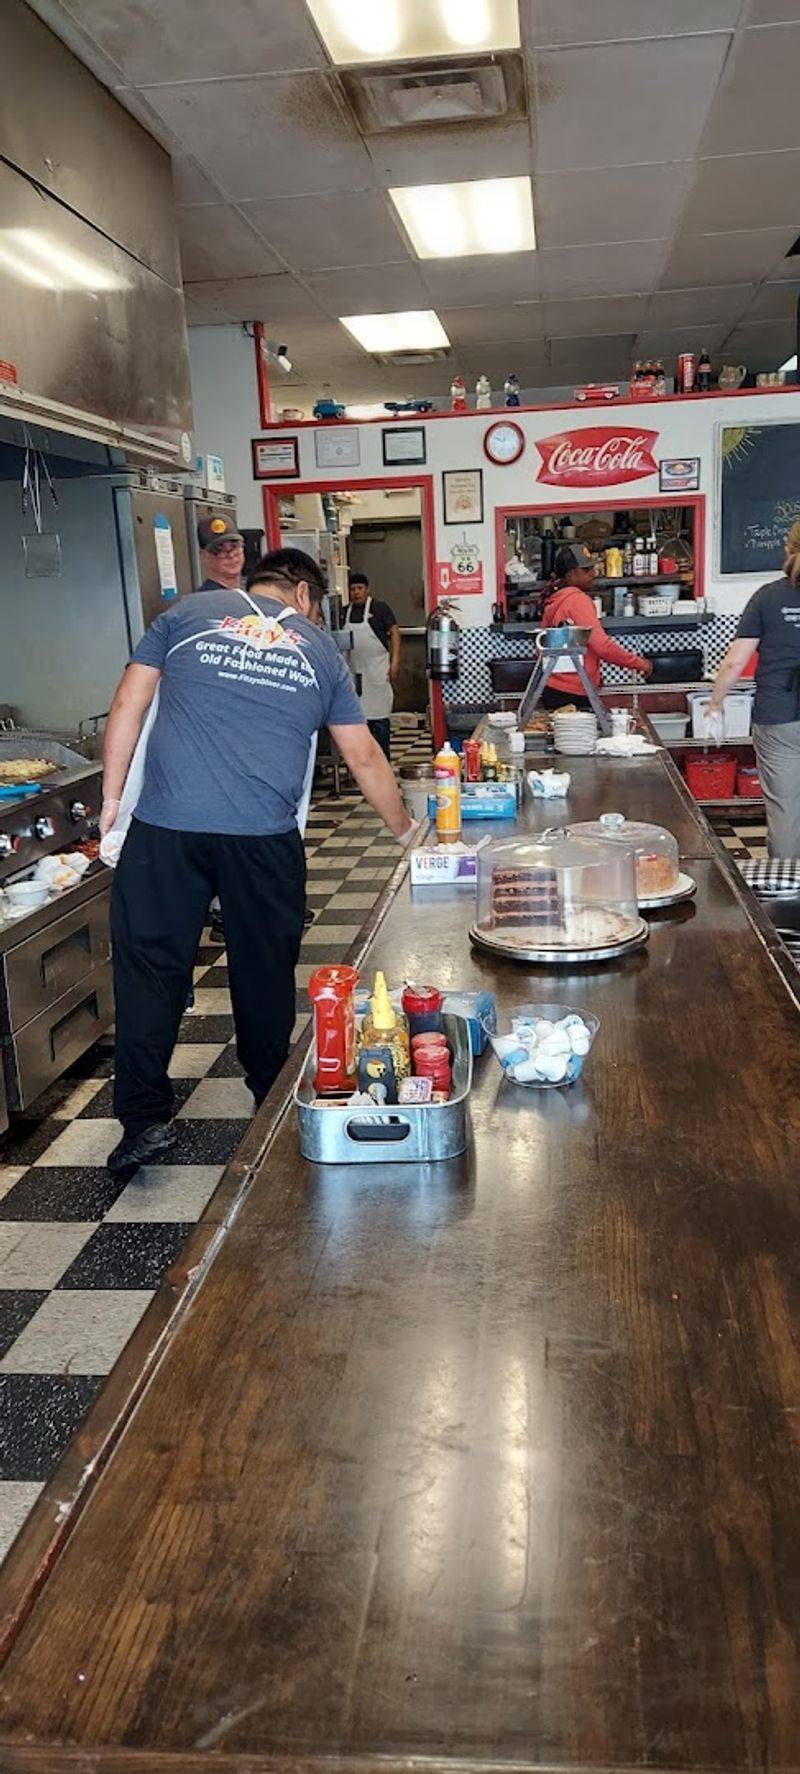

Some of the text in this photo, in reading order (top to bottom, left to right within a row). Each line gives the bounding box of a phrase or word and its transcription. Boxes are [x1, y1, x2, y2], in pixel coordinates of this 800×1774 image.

[548, 436, 647, 474] Coca-Cola
[457, 561, 474, 573] 66
[195, 641, 229, 654] Great
[265, 653, 299, 667] Made
[200, 653, 222, 666] Old
